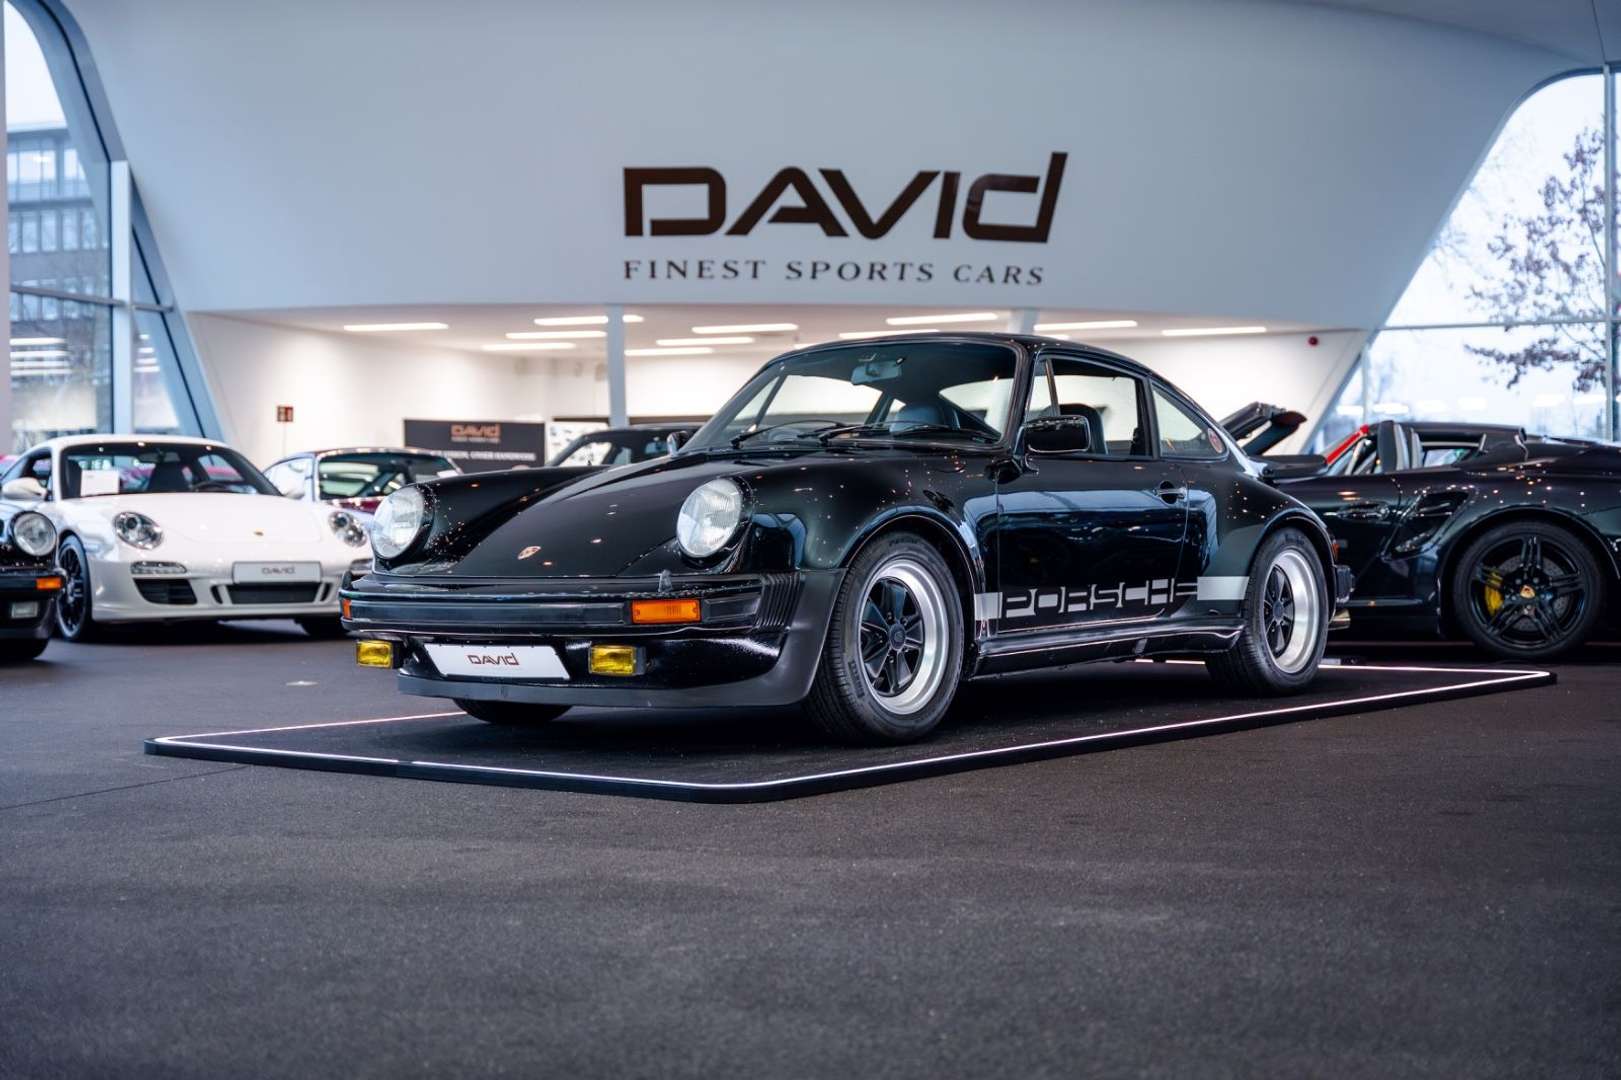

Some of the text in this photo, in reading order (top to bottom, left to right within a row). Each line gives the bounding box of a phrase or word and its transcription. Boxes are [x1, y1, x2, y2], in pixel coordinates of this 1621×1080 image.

[624, 260, 1044, 286] FINEST SPORTS CARS
[1002, 577, 1197, 619] PORSCHE
